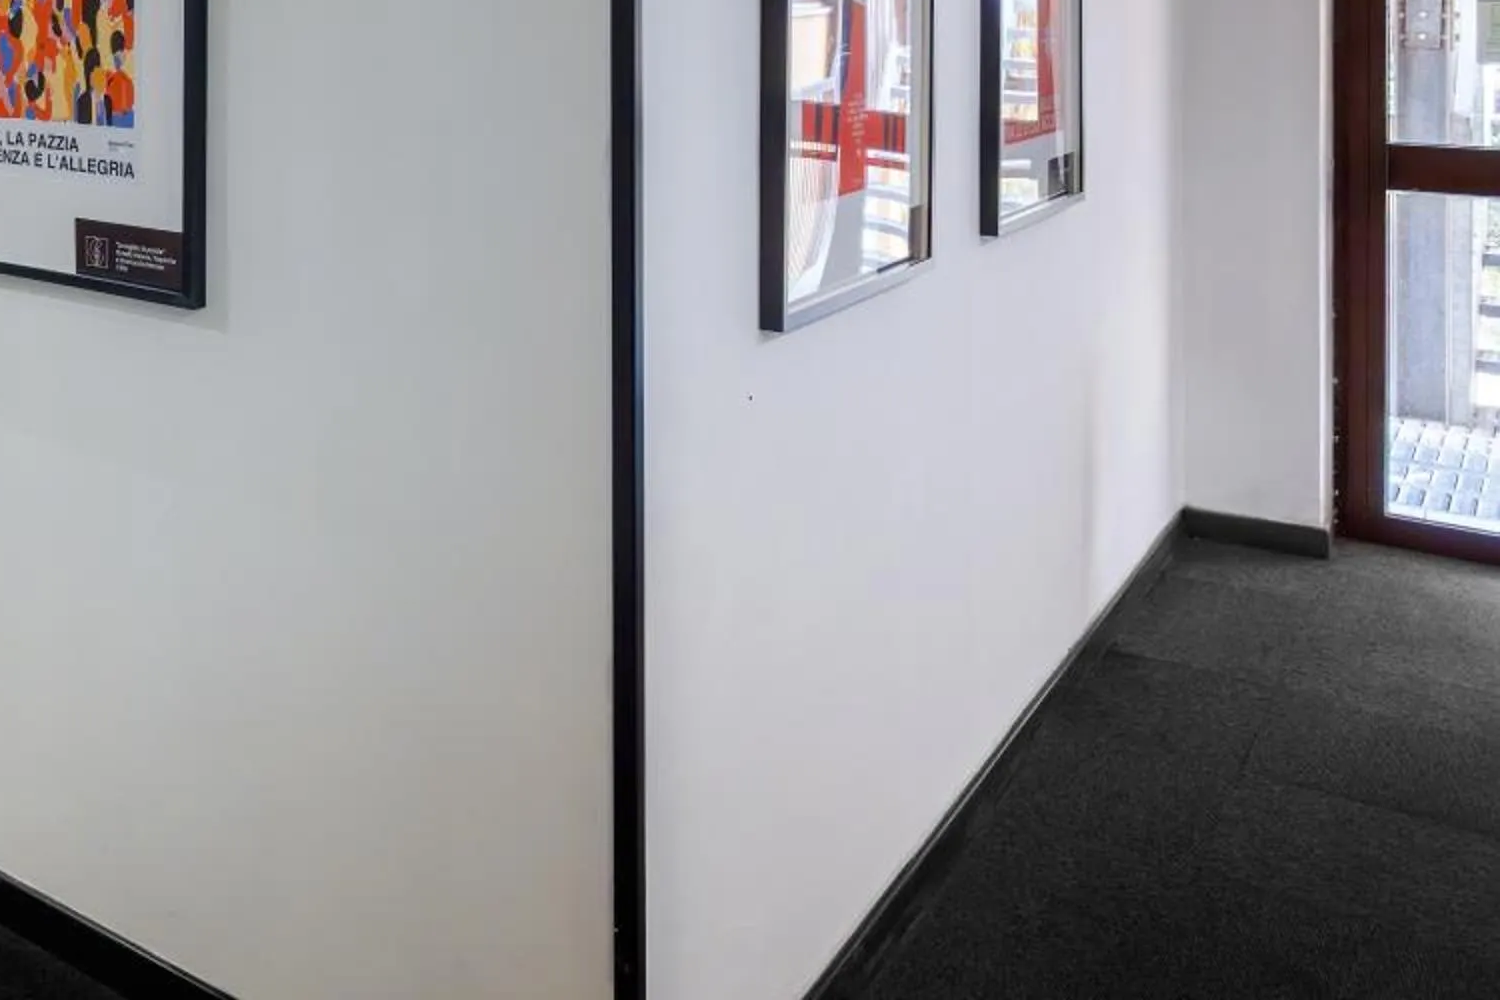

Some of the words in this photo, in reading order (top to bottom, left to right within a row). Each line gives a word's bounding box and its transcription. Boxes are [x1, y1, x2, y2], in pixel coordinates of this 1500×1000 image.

[6, 131, 25, 146] LA
[29, 133, 80, 152] PAZZIA
[33, 153, 43, 167] E
[47, 155, 135, 179] L'ALLEGRIA
